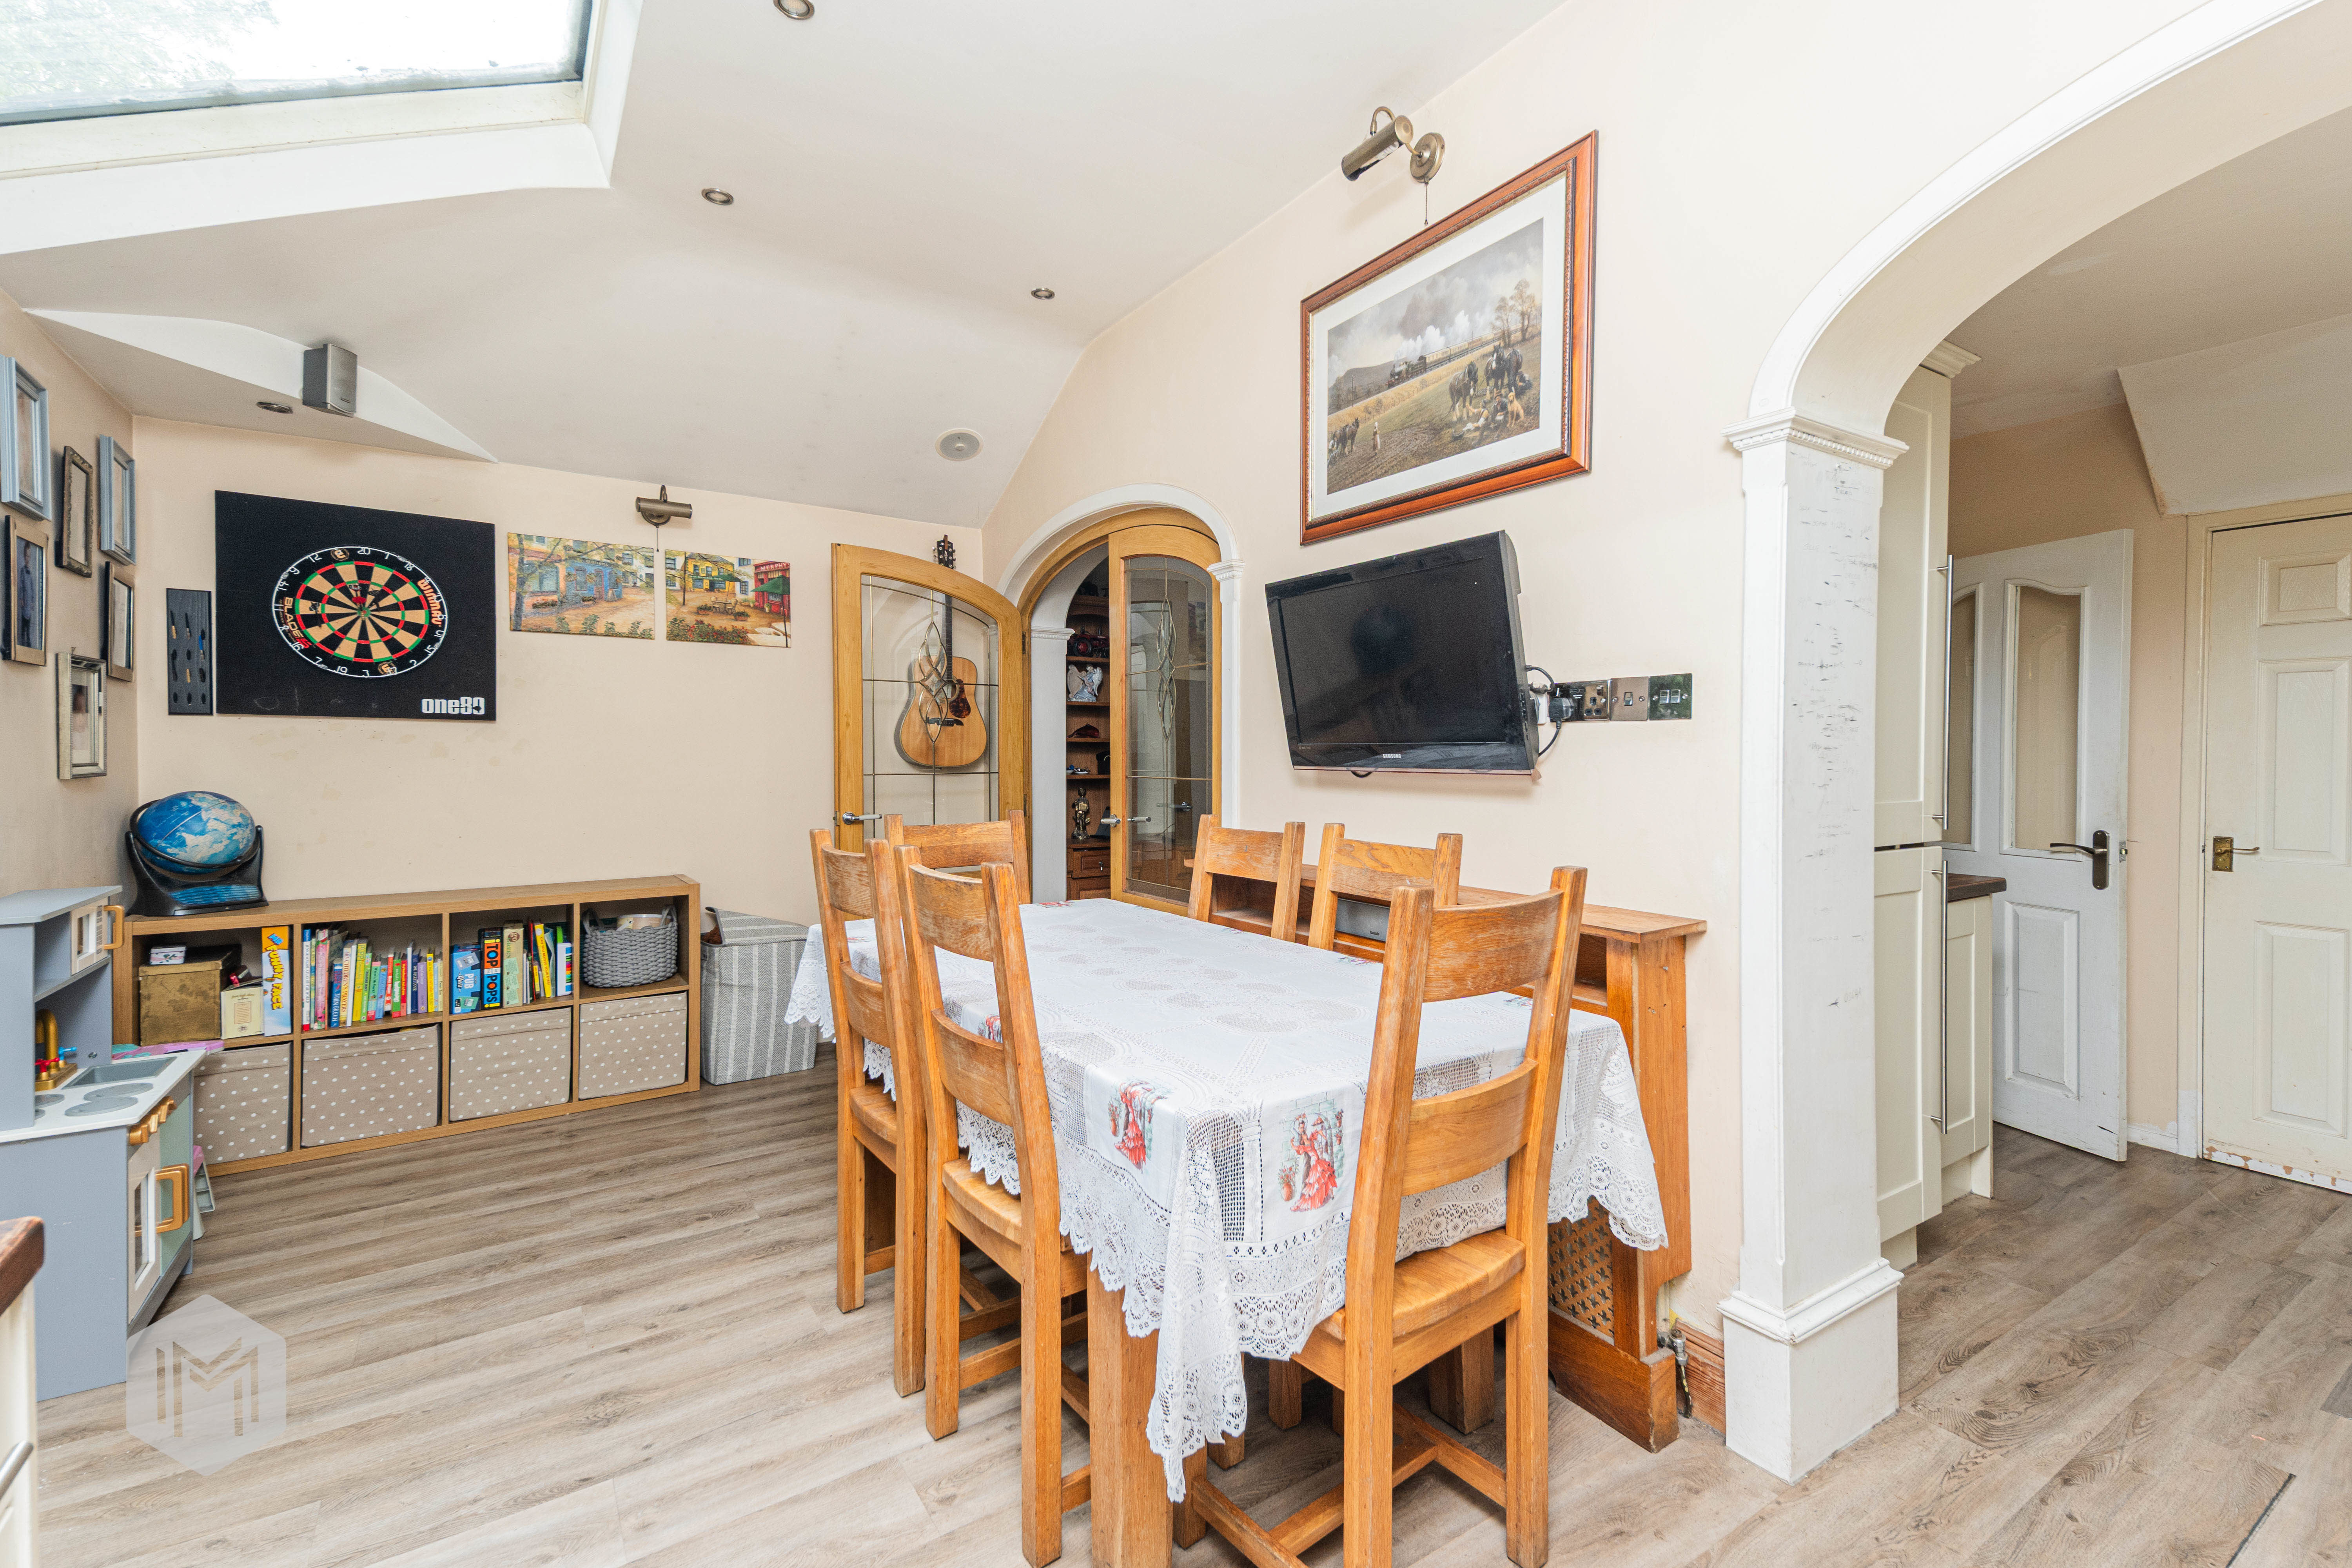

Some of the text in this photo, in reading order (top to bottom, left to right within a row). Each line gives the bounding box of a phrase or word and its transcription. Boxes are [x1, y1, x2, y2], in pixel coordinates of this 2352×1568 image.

[306, 553, 322, 563] 12
[404, 561, 414, 571] 18
[276, 581, 289, 591] 14
[434, 630, 445, 640] 10
[290, 642, 304, 651] 16
[424, 645, 435, 655] 15
[334, 666, 348, 674] 19
[486, 944, 499, 967] TOP
[265, 933, 285, 1010] MR FUNNY FACE
[464, 973, 474, 989] PUB
[331, 1005, 339, 1022] GREEN
